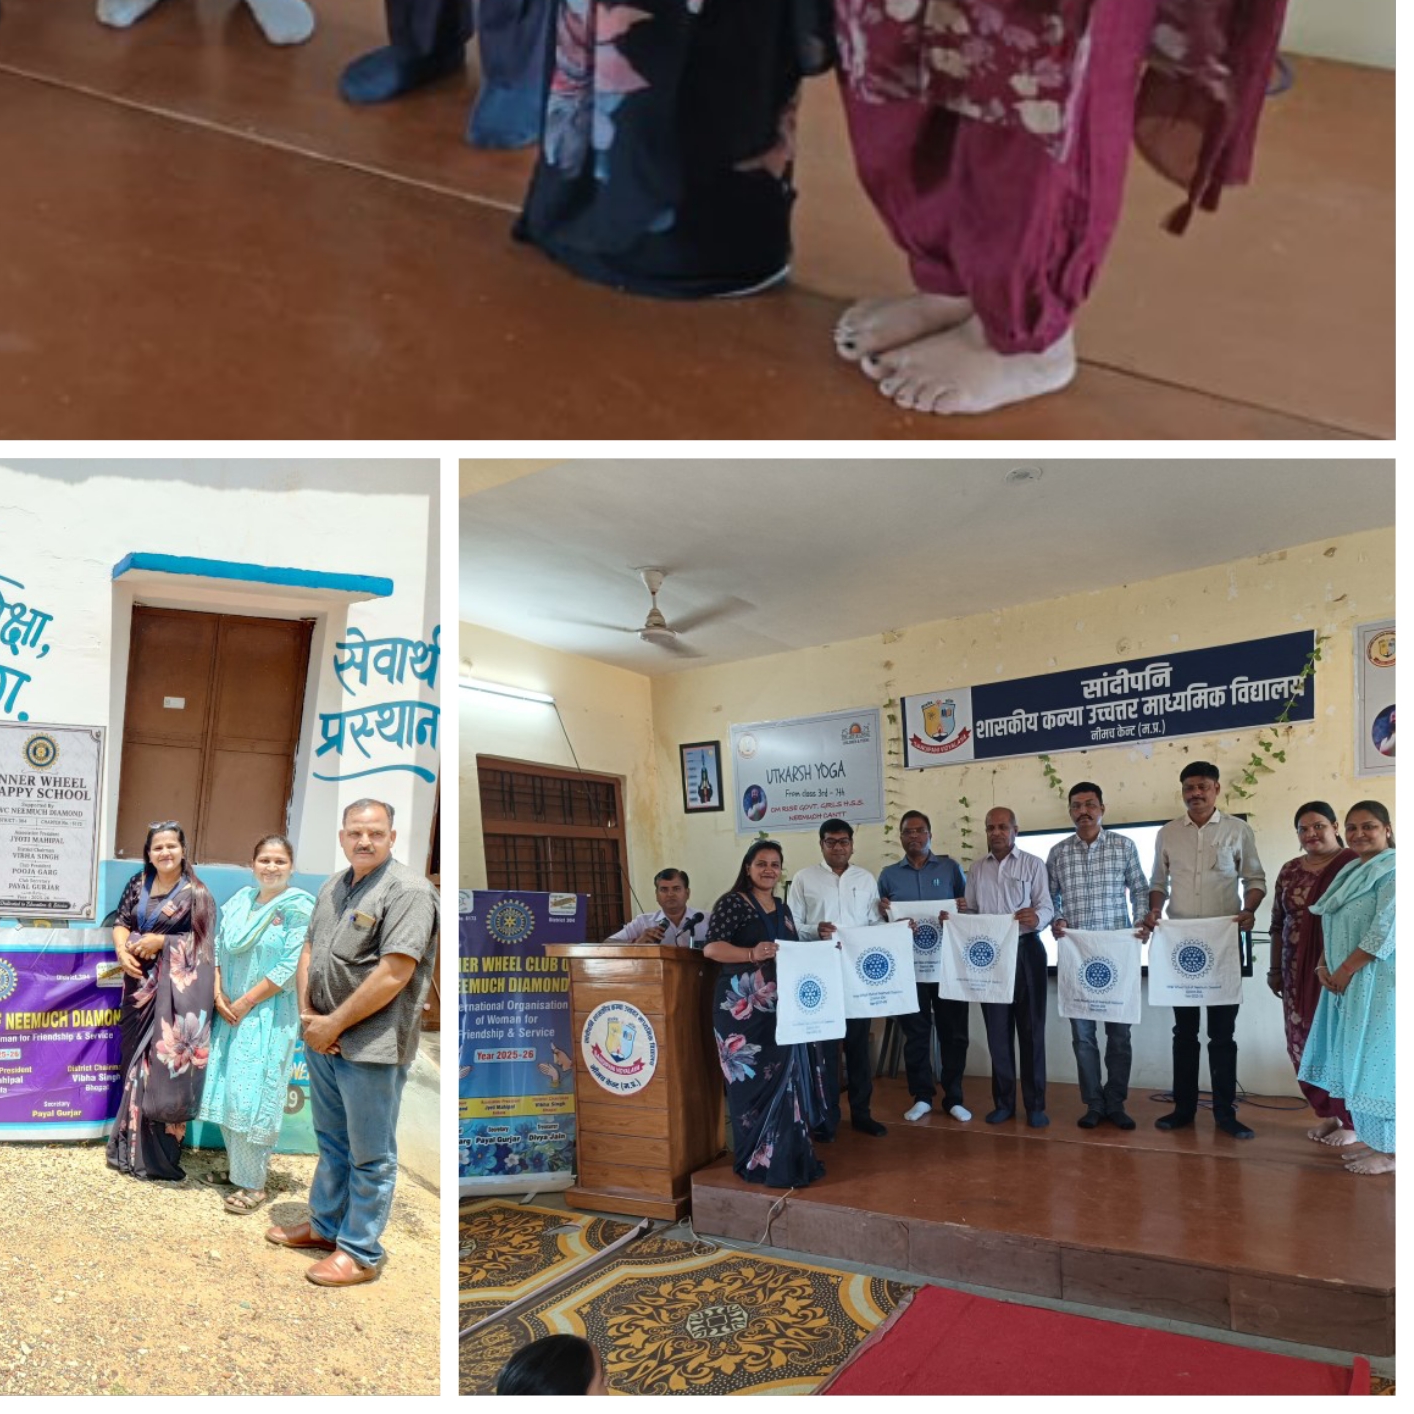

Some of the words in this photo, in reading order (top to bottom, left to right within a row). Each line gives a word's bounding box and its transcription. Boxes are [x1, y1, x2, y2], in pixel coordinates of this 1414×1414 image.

[1081, 662, 1173, 699] सांदीपनि
[976, 708, 1038, 739] शासकीय
[1041, 706, 1084, 731] कन्या
[1141, 683, 1227, 716] माध्यमिक
[1230, 675, 1306, 705] विद्यालय
[1090, 727, 1115, 742] नीमच
[1137, 719, 1166, 737] (म.प्र.)
[766, 764, 812, 785] UTKARSH
[814, 760, 846, 780] YOGA
[41, 776, 86, 788] WHEEL
[37, 788, 91, 801] SCHOOL
[817, 788, 828, 797] 3rd
[11, 807, 47, 815] NEEMUCH
[49, 809, 83, 817] DIAMOND
[482, 956, 522, 972] WHEEL
[526, 956, 558, 972] CLUB
[509, 977, 569, 992] DIAMOND
[507, 1000, 568, 1012] Organisation
[6, 1010, 69, 1030] NEEMUCH
[72, 1009, 121, 1027] DIAMON
[476, 1015, 484, 1025] of
[487, 1016, 521, 1024] Woman
[525, 1015, 538, 1024] for
[20, 1034, 30, 1042] for
[33, 1033, 74, 1043] Friendship
[76, 1032, 82, 1040] &
[85, 1031, 114, 1040] Service
[507, 1028, 515, 1038] &
[519, 1027, 555, 1038] Service
[477, 1051, 494, 1060] Year
[0, 1066, 32, 1074] President
[72, 1074, 96, 1083] Vibha
[98, 1073, 121, 1083] Singh
[289, 1090, 298, 1108] 9
[32, 1110, 55, 1118] Payal
[56, 1110, 82, 1119] Gurjar
[476, 1136, 495, 1144] Payal
[498, 1135, 520, 1143] Gurjar
